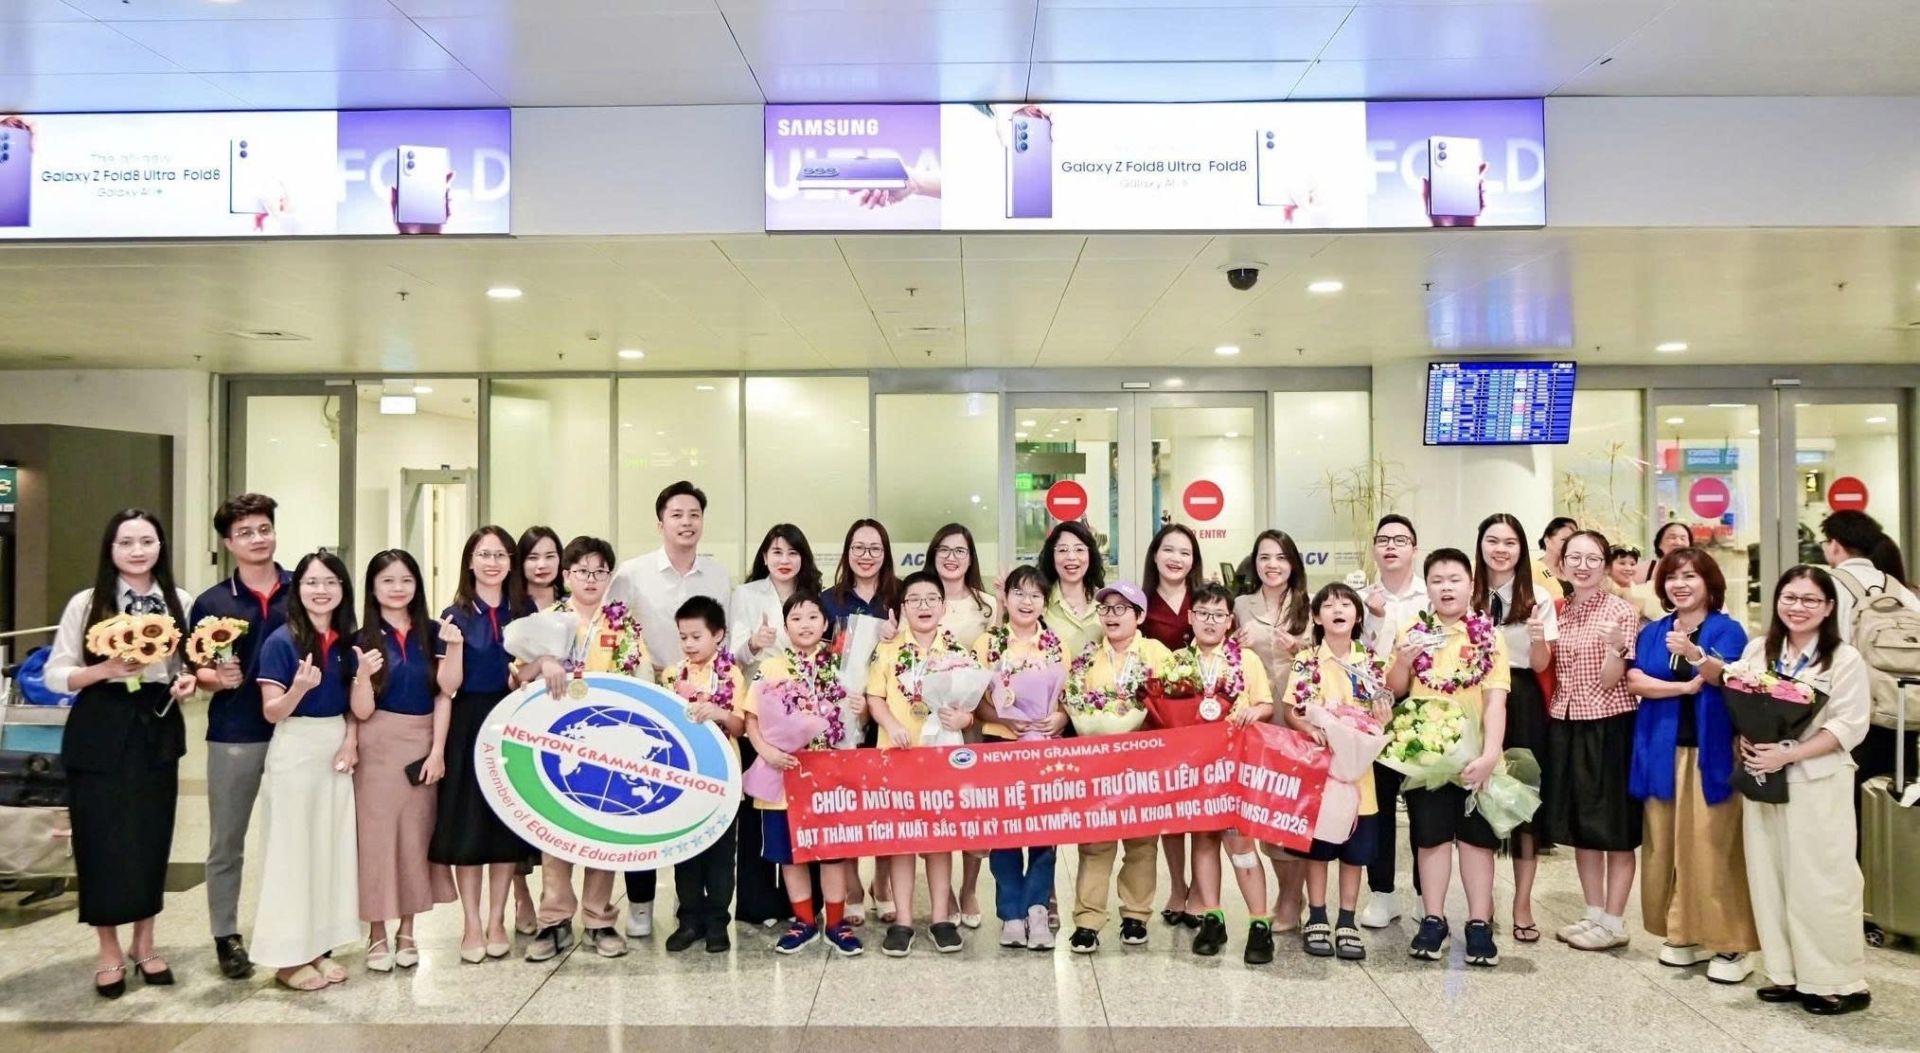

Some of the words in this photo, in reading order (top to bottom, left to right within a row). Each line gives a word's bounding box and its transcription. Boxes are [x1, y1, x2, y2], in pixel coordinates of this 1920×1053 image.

[777, 118, 880, 137] SAMSUNG
[1061, 161, 1113, 175] Galaxy
[1115, 161, 1122, 173] Z
[1126, 161, 1164, 173] Fold8
[1168, 160, 1201, 172] Ultra
[1209, 160, 1247, 172] Fold8
[41, 170, 90, 184] Galaxy
[92, 170, 100, 182] Z
[103, 169, 140, 182] Fold8
[143, 169, 176, 181] Ultra
[183, 169, 221, 181] Fold8
[1199, 529, 1227, 539] ENTRY
[901, 553, 925, 566] AC
[1299, 552, 1329, 565] CV
[482, 742, 495, 755] A
[983, 750, 1040, 763] NEWTON
[1044, 744, 1109, 758] GRAMMAR
[1113, 738, 1166, 752] SCHOOL
[503, 724, 574, 755] NEWTON
[577, 746, 660, 779] GRAMMAR
[666, 769, 727, 797] SCHOOL
[485, 755, 515, 810] member
[811, 785, 857, 814] CHỨC
[862, 787, 915, 811] MỪNG
[920, 789, 954, 815] HỌC
[959, 787, 999, 809] SINH
[1004, 780, 1026, 810] HỆ
[1031, 777, 1086, 804] THỐNG
[1091, 767, 1160, 797] TRƯỜNG
[1165, 763, 1199, 790] LIÊN
[1203, 756, 1235, 785] CẤP
[513, 807, 528, 823] of
[822, 823, 863, 844] THÀNH
[866, 820, 894, 841] TÍCH
[898, 818, 929, 838] XUẤT
[932, 818, 957, 837] SẮC
[960, 820, 979, 840] TẠI
[1002, 818, 1022, 834] THI
[1025, 811, 1081, 832] OLYMPIC
[1084, 806, 1117, 829] TOÁN
[1120, 805, 1138, 825] VÀ
[1140, 805, 1173, 823] KHOA
[1176, 799, 1201, 820] HỌC
[1203, 792, 1236, 816] QUỐC
[1272, 810, 1308, 836] 2026
[526, 819, 577, 854] EQuest
[578, 846, 657, 863] Education
